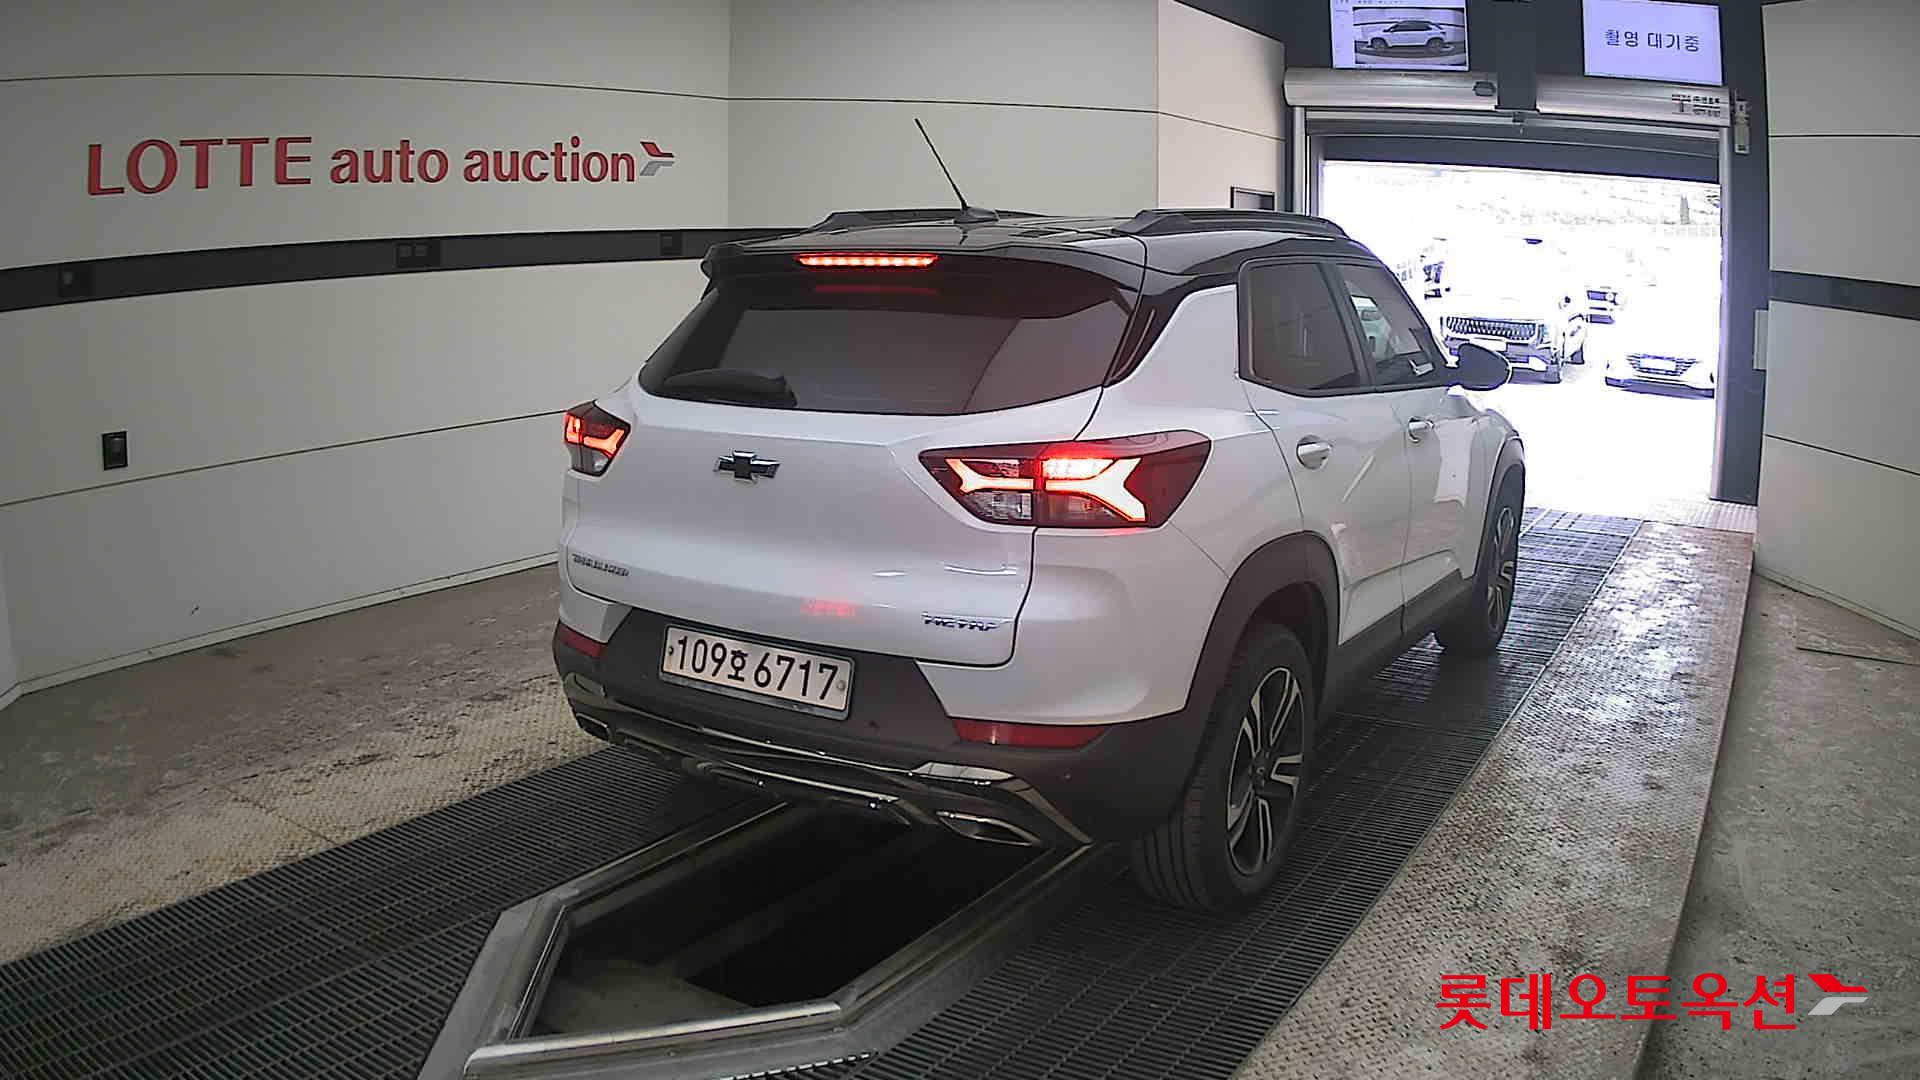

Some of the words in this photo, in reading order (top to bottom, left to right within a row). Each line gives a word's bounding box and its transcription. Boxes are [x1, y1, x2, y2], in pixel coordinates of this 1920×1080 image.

[1605, 29, 1639, 48] 촬영
[1647, 32, 1699, 52] 대기중
[88, 136, 312, 195] LOTTE
[330, 140, 449, 184] auto
[463, 136, 636, 184] auction
